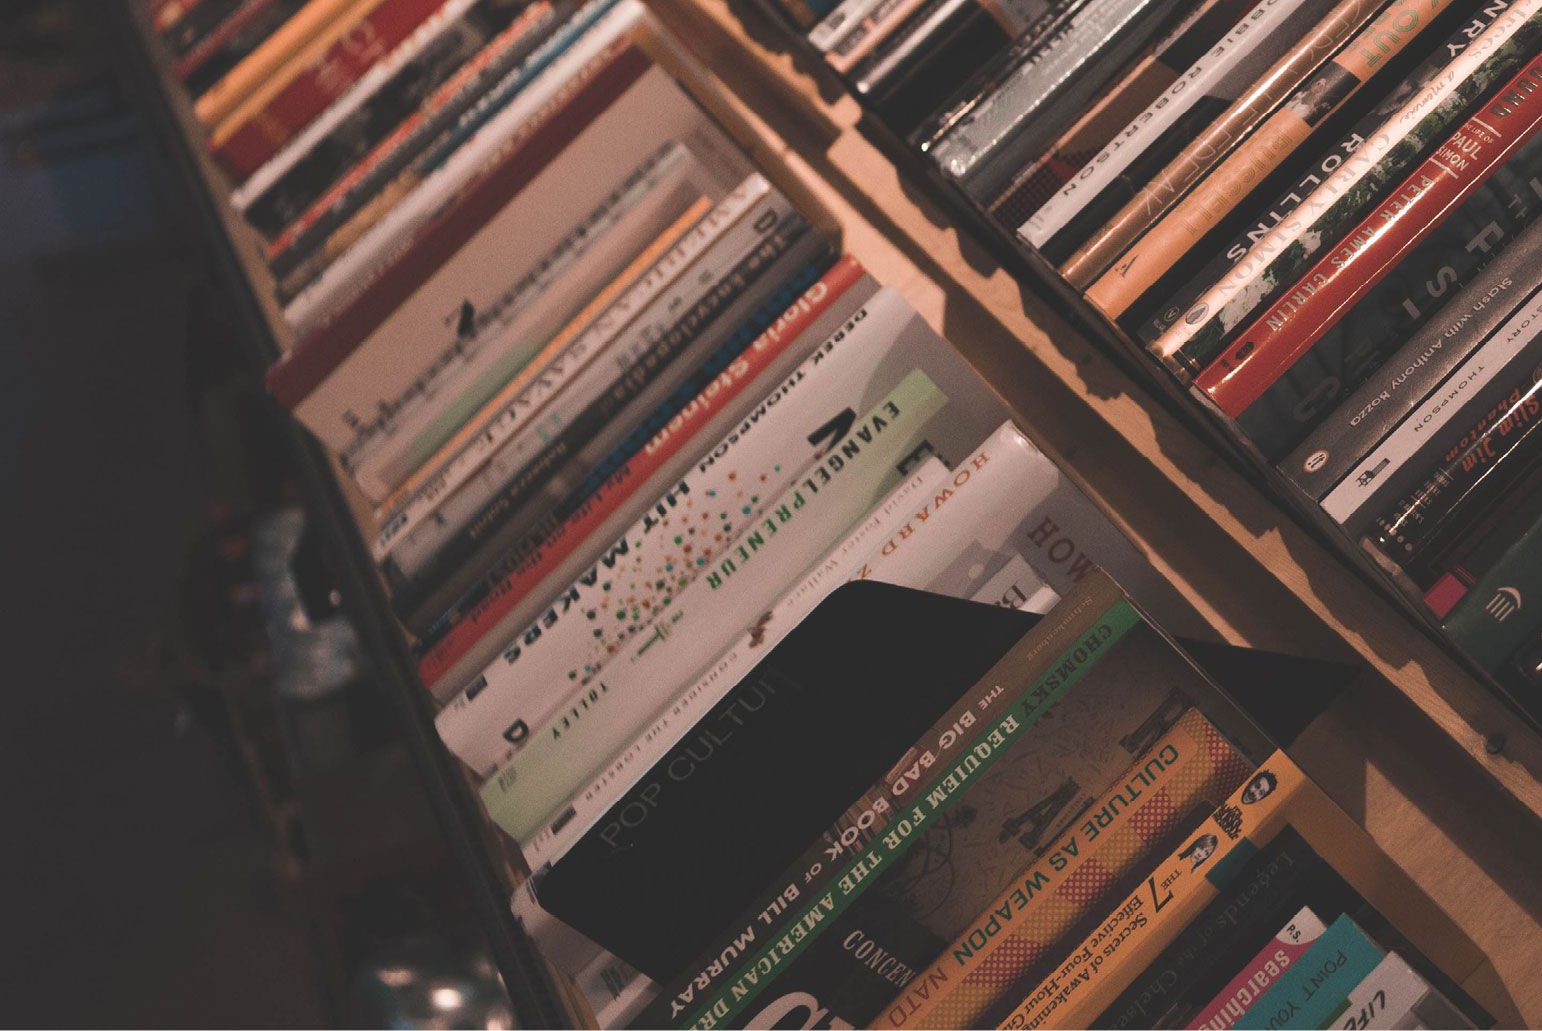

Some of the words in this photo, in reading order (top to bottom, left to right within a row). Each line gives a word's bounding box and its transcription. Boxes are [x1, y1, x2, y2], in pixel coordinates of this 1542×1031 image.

[1058, 63, 1204, 200] ROBERTSON
[1221, 127, 1368, 269] ROLLINS
[1375, 171, 1435, 226] PETER
[1326, 222, 1380, 271] AMES
[748, 275, 832, 359] Gloria
[1262, 269, 1330, 333] CARLIN
[1471, 275, 1513, 313] Slash
[805, 305, 870, 367] DEREK
[1442, 311, 1473, 340] with
[1387, 337, 1444, 392] Anthony
[639, 350, 753, 463] Steinem
[694, 366, 807, 475] THOMPSON
[1348, 389, 1391, 429] Bozza
[1412, 363, 1485, 433] THOMPSON
[1443, 385, 1523, 467] Phantom
[1494, 391, 1542, 441] Slim
[1457, 434, 1501, 479] Jim
[633, 478, 693, 535] HIT
[699, 395, 902, 595] EVANGELPRENEUR
[875, 447, 992, 563] HOWARD
[497, 535, 634, 668] MAKERS
[973, 681, 1006, 711] THE
[1012, 617, 1116, 719] CHOMSKY
[545, 678, 611, 743] TOLLEY
[932, 707, 979, 751] BIG
[884, 747, 938, 799] BAD
[919, 711, 1022, 810] REQUIEM
[1075, 739, 1182, 844] CULTURE
[594, 776, 670, 852] POP
[820, 793, 892, 863] BOOK
[876, 804, 928, 852] FOR
[798, 859, 825, 884] OF
[832, 847, 884, 895] THE
[1043, 834, 1086, 874] AS
[1158, 866, 1183, 891] THE
[753, 881, 803, 928] BILL
[948, 866, 1053, 969] WEAPON
[1086, 892, 1145, 951] Effective
[1133, 873, 1175, 915] 7
[724, 889, 841, 1002] AMERICAN
[1085, 951, 1108, 974] of
[1099, 909, 1149, 960] Secrets
[660, 922, 761, 1020] MURRAY
[883, 965, 951, 1030] NATO
[1019, 940, 1095, 1017] Four-Hour
